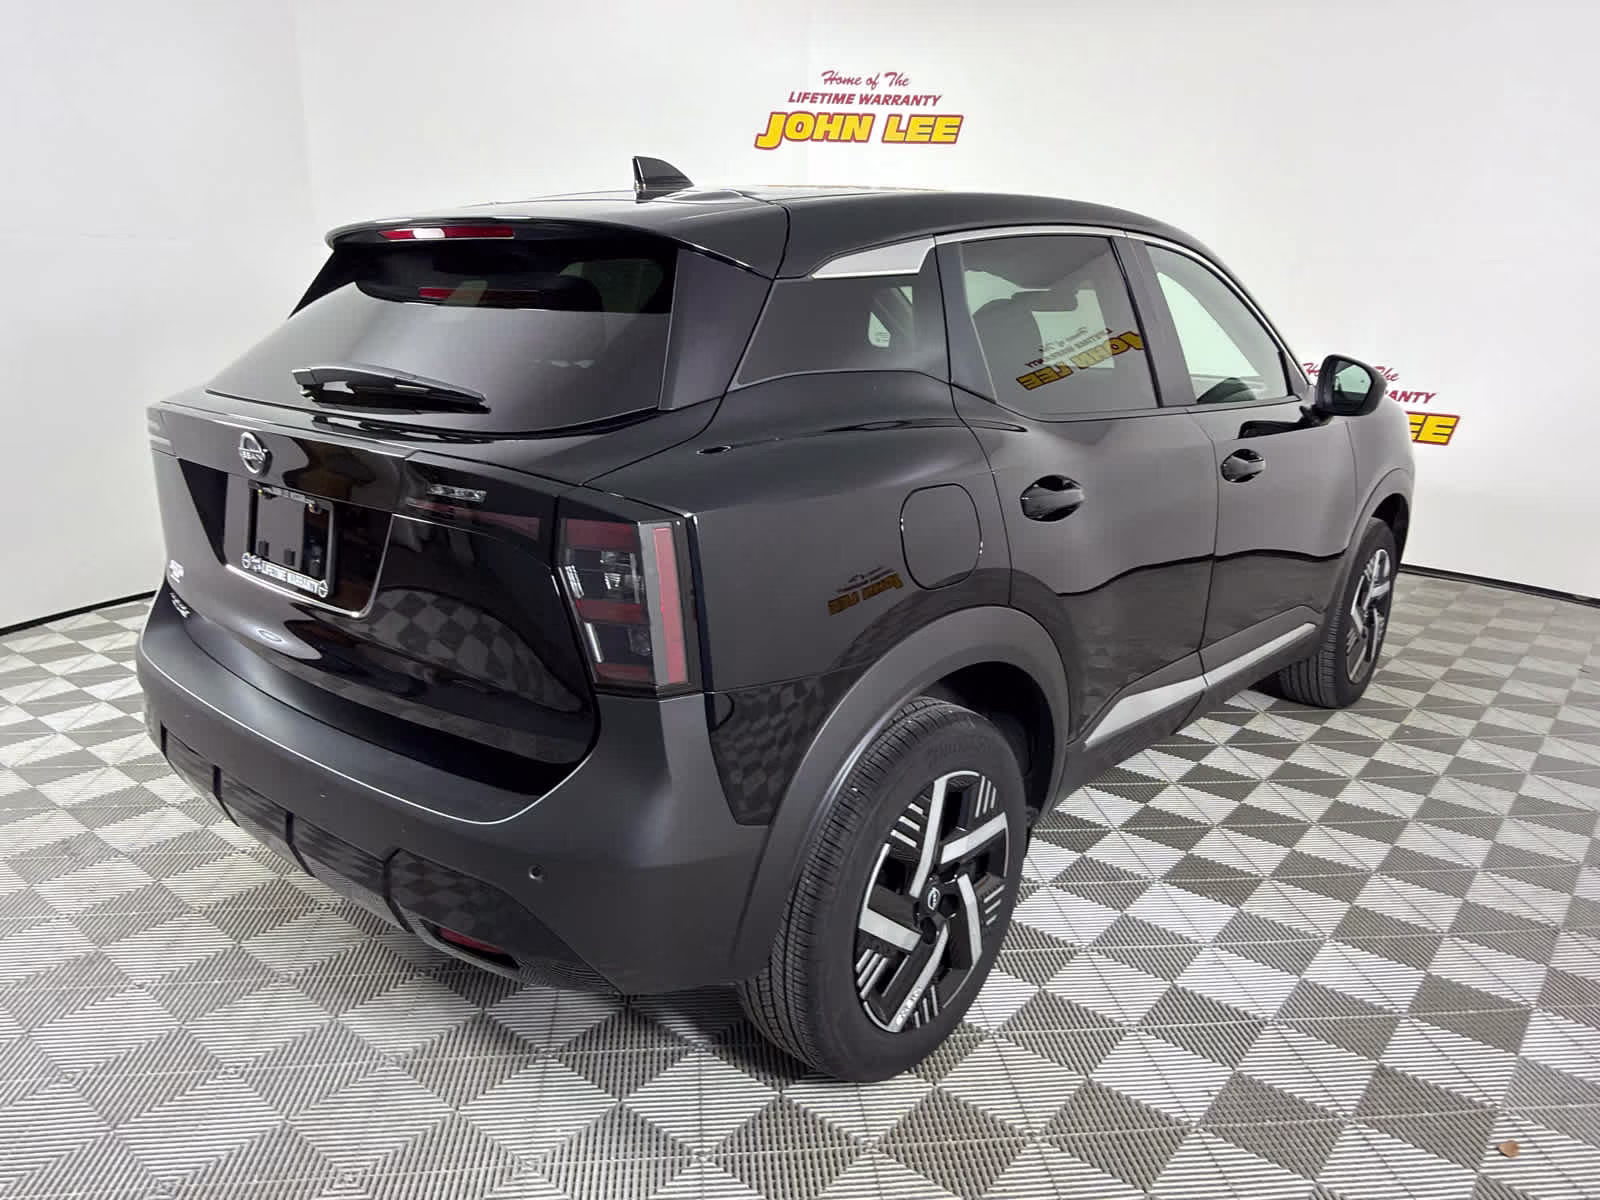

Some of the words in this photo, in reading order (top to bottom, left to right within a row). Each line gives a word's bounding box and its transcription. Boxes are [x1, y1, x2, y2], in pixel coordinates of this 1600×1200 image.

[821, 70, 862, 86] Home
[865, 73, 880, 91] of
[884, 72, 910, 88] The
[788, 91, 855, 105] LIFETIME
[858, 93, 942, 107] WARRANTY
[754, 111, 876, 150] JOHN
[881, 113, 964, 144] LEE
